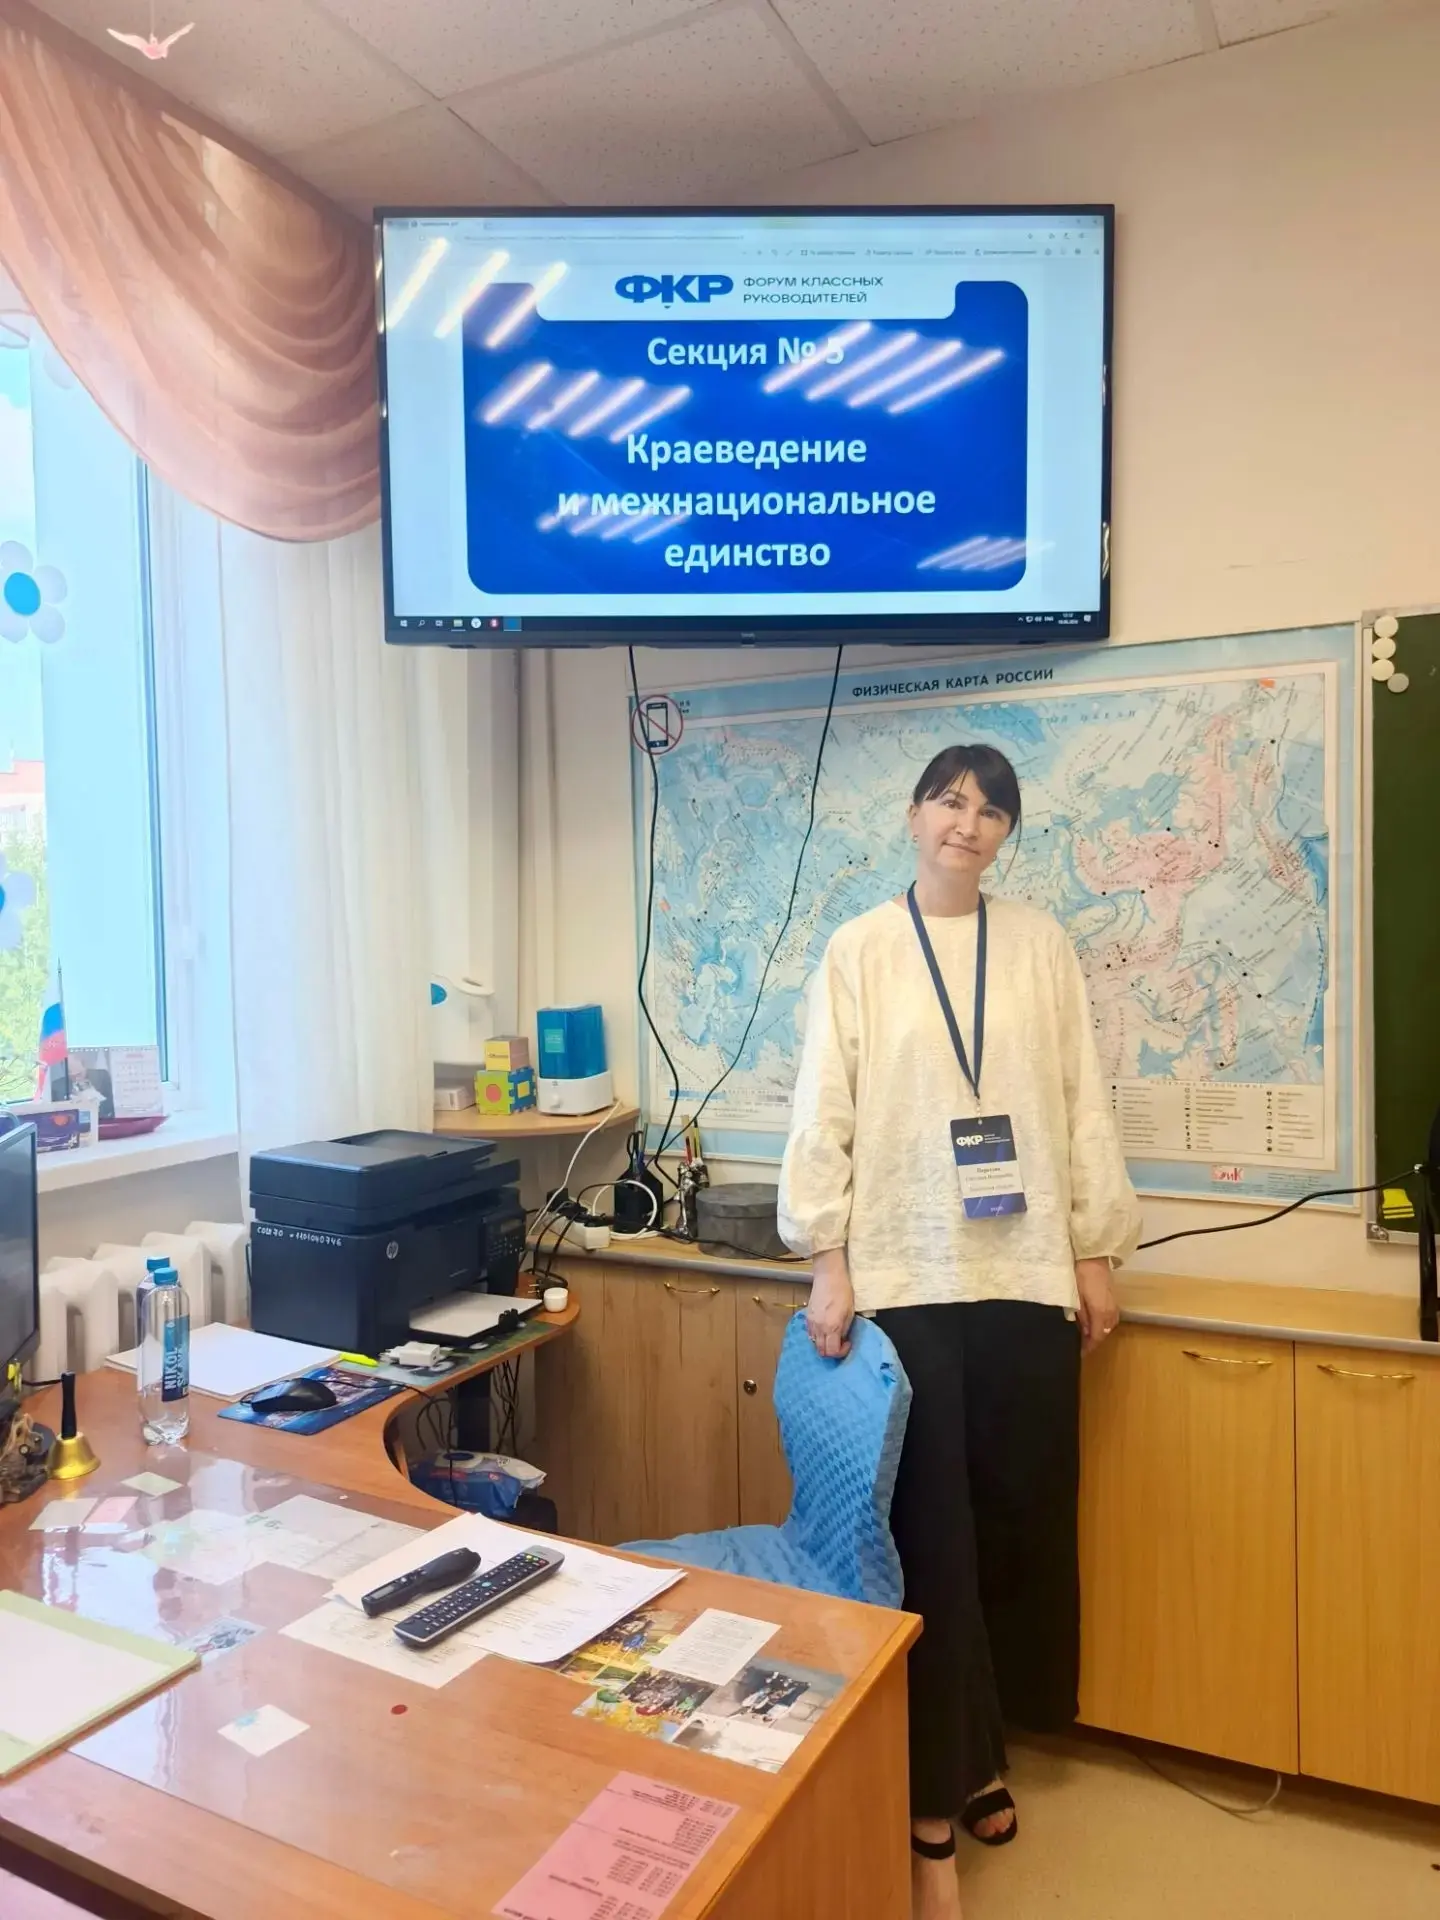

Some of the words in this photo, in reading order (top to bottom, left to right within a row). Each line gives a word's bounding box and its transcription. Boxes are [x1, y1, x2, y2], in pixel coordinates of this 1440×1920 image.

[615, 274, 734, 303] ФКР
[743, 276, 797, 288] ФОРУМ
[801, 275, 883, 288] КЛАССНЫХ
[743, 291, 867, 305] РУКОВОДИТЕЛЕЙ
[647, 338, 767, 370] Секция
[778, 337, 816, 365] №
[626, 434, 867, 468] Краеведение
[558, 493, 582, 515] и
[591, 489, 936, 521] межнациональное
[664, 541, 831, 573] единство
[852, 680, 940, 698] ФИЗИЧЕСКАЯ
[945, 674, 989, 689] КАРТА
[996, 668, 1054, 684] РОССИИ
[956, 1134, 984, 1147] ФКР
[164, 1347, 178, 1390] NIKOL
